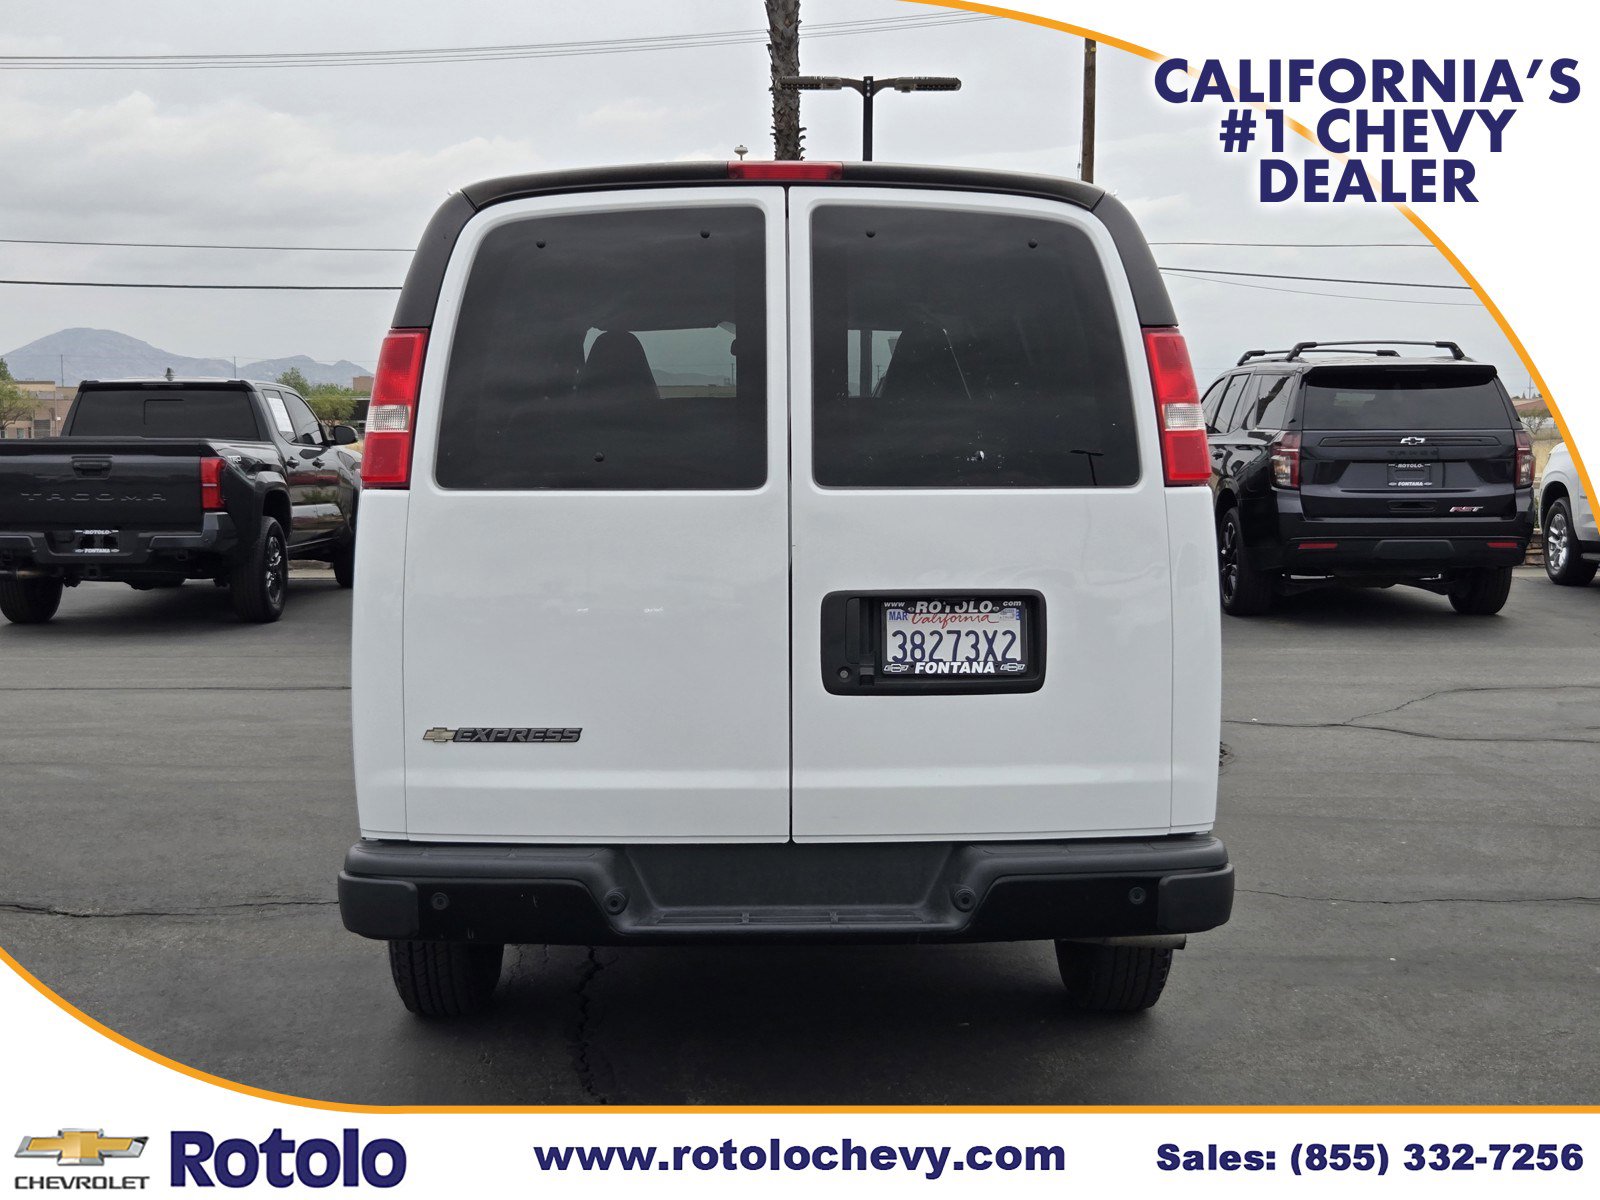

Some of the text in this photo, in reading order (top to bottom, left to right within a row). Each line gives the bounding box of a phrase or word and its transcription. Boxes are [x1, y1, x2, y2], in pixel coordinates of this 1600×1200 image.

[888, 610, 909, 621] MAR
[911, 612, 1000, 630] California
[892, 629, 1017, 663] 38273X2
[914, 662, 996, 674] FONTANA
[454, 727, 582, 742] EXPRESS
